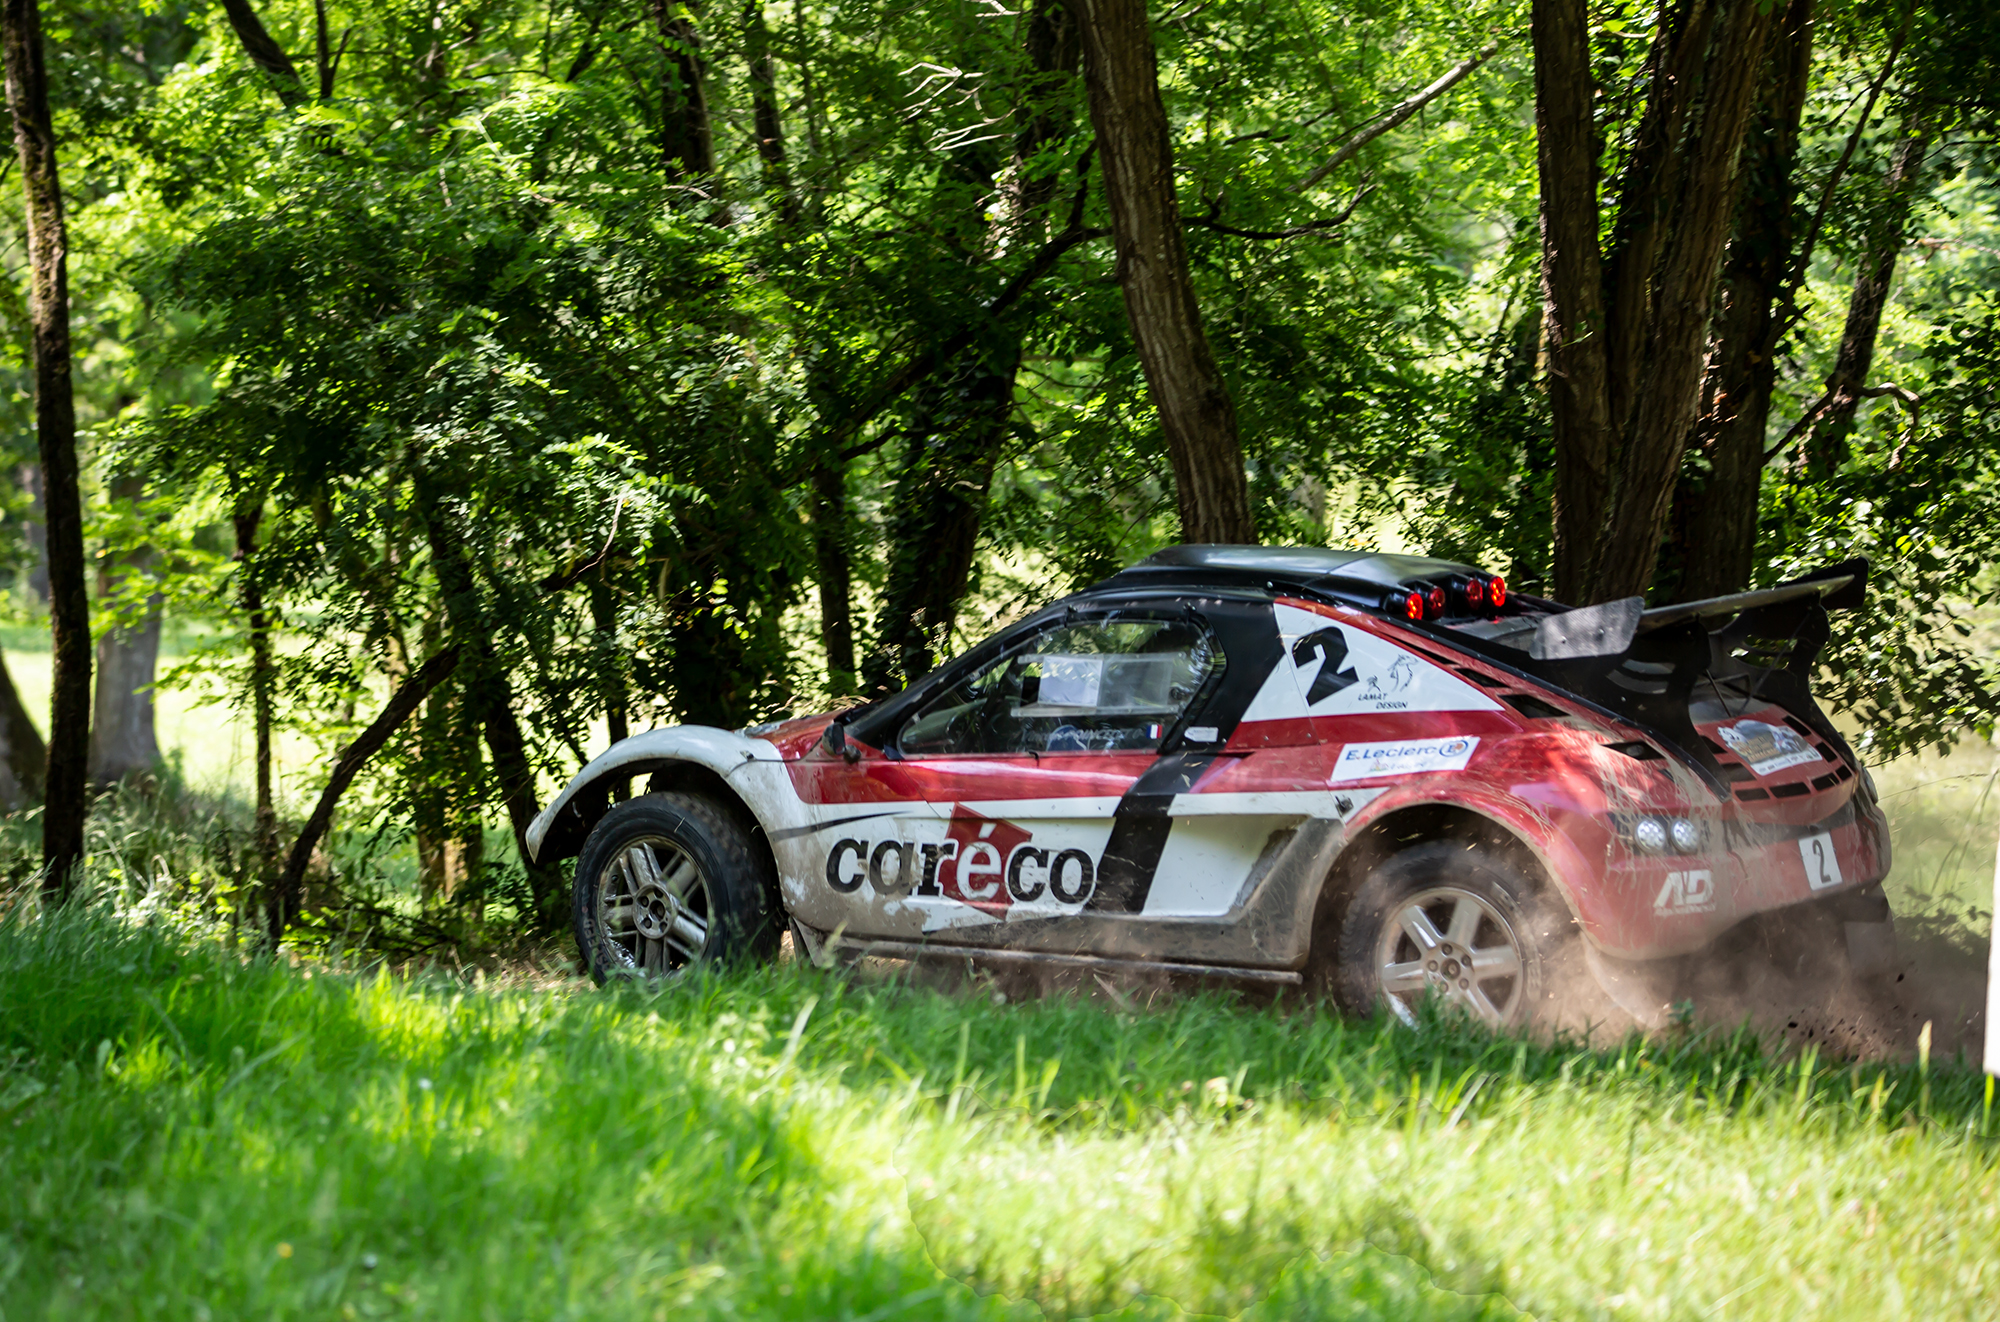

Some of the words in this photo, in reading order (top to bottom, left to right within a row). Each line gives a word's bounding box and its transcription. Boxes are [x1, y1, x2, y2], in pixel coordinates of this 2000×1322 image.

[1292, 626, 1359, 707] 2
[1376, 701, 1408, 710] DESIGN
[1345, 745, 1437, 761] E.Leclerc
[826, 823, 1094, 904] caréco
[1812, 839, 1832, 884] 2
